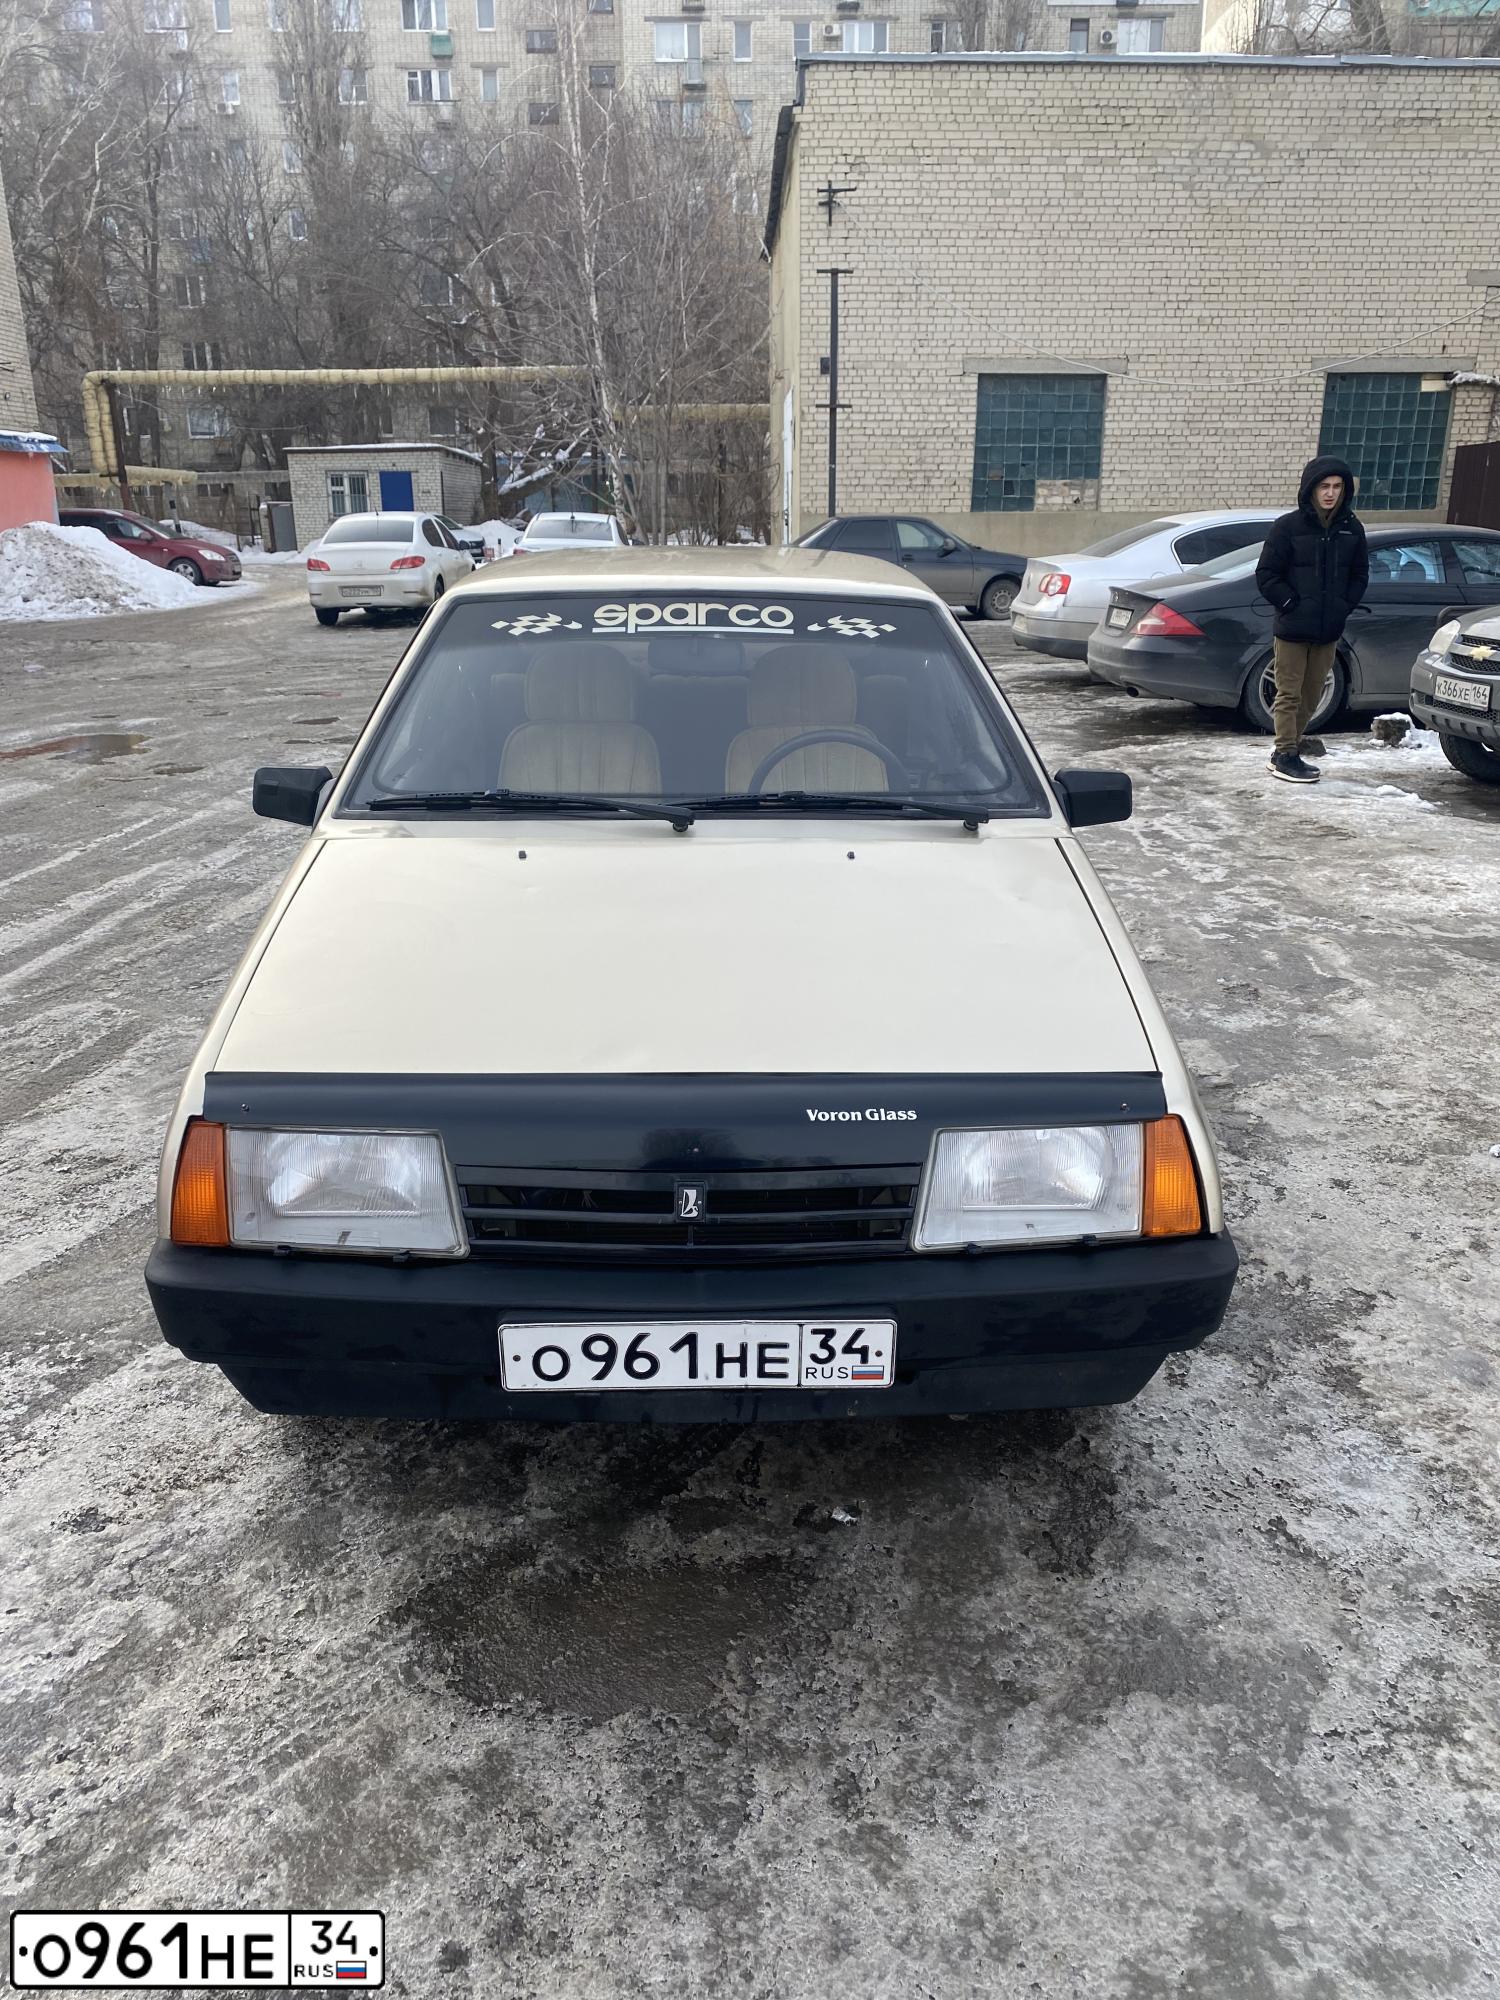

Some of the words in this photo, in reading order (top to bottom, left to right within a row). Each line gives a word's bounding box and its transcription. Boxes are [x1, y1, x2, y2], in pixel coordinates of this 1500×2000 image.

[593, 603, 794, 633] sparco
[1472, 686, 1487, 700] 164
[806, 1109, 862, 1121] Voron
[865, 1108, 918, 1121] Glass
[809, 1327, 870, 1365] 34
[805, 1366, 850, 1380] RUS
